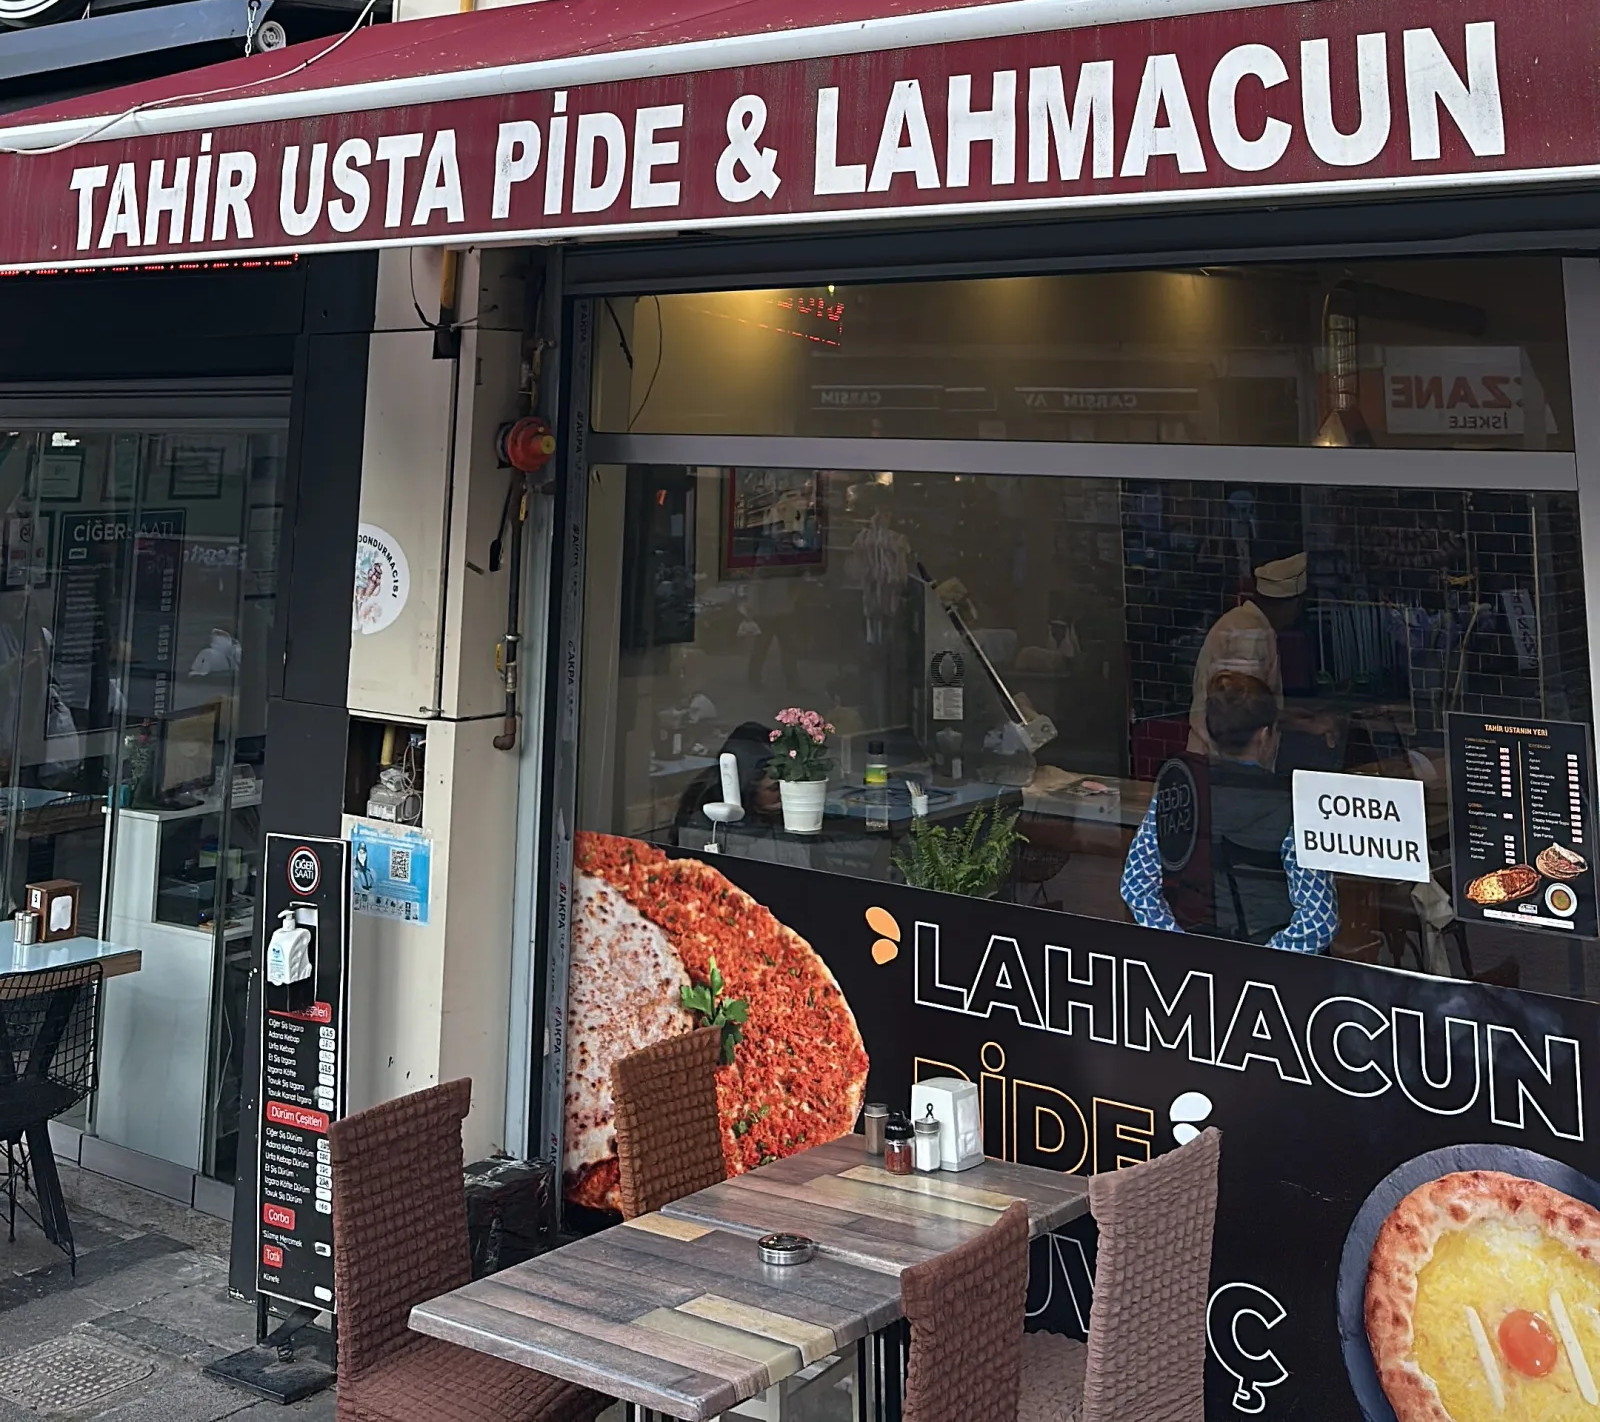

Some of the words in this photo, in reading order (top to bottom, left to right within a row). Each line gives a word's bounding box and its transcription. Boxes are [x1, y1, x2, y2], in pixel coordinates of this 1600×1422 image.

[70, 132, 256, 250] TAHİR
[279, 129, 464, 236] USTA
[491, 91, 684, 220] PİDE
[716, 94, 781, 204] &
[813, 21, 1507, 196] LAHMACUN
[1484, 724, 1503, 732] TAHİR
[1318, 793, 1400, 822] ÇORBA
[1304, 829, 1421, 863] BULUNUR
[558, 893, 567, 929] AKPA
[268, 1030, 284, 1039] Adana
[284, 1033, 300, 1045] Kebap
[553, 1019, 562, 1054] AKPA
[914, 920, 1584, 1141] LAHMACUN
[268, 1042, 279, 1051] Urfa
[279, 1044, 296, 1055] Kebap
[267, 1075, 282, 1086] Tavuk
[267, 1087, 282, 1097] Tavuk
[271, 1106, 295, 1121] Dürüm
[295, 1110, 322, 1127] Çeşitleri
[914, 1041, 1155, 1175] İDE
[266, 1127, 278, 1138] Ciğer
[287, 1132, 303, 1143] Dürüm
[266, 1140, 281, 1150] Adana
[281, 1143, 297, 1154] Kebap
[298, 1147, 315, 1158] Dürüm
[265, 1152, 276, 1161] Urfa
[276, 1155, 292, 1165] Kebap
[292, 1158, 309, 1169] Dürüm
[277, 1166, 294, 1177] Dürüm
[264, 1187, 278, 1198] Tavuk
[286, 1193, 303, 1204] Dürüm
[293, 1182, 311, 1193] Dürüm
[268, 1209, 290, 1224] Çorba
